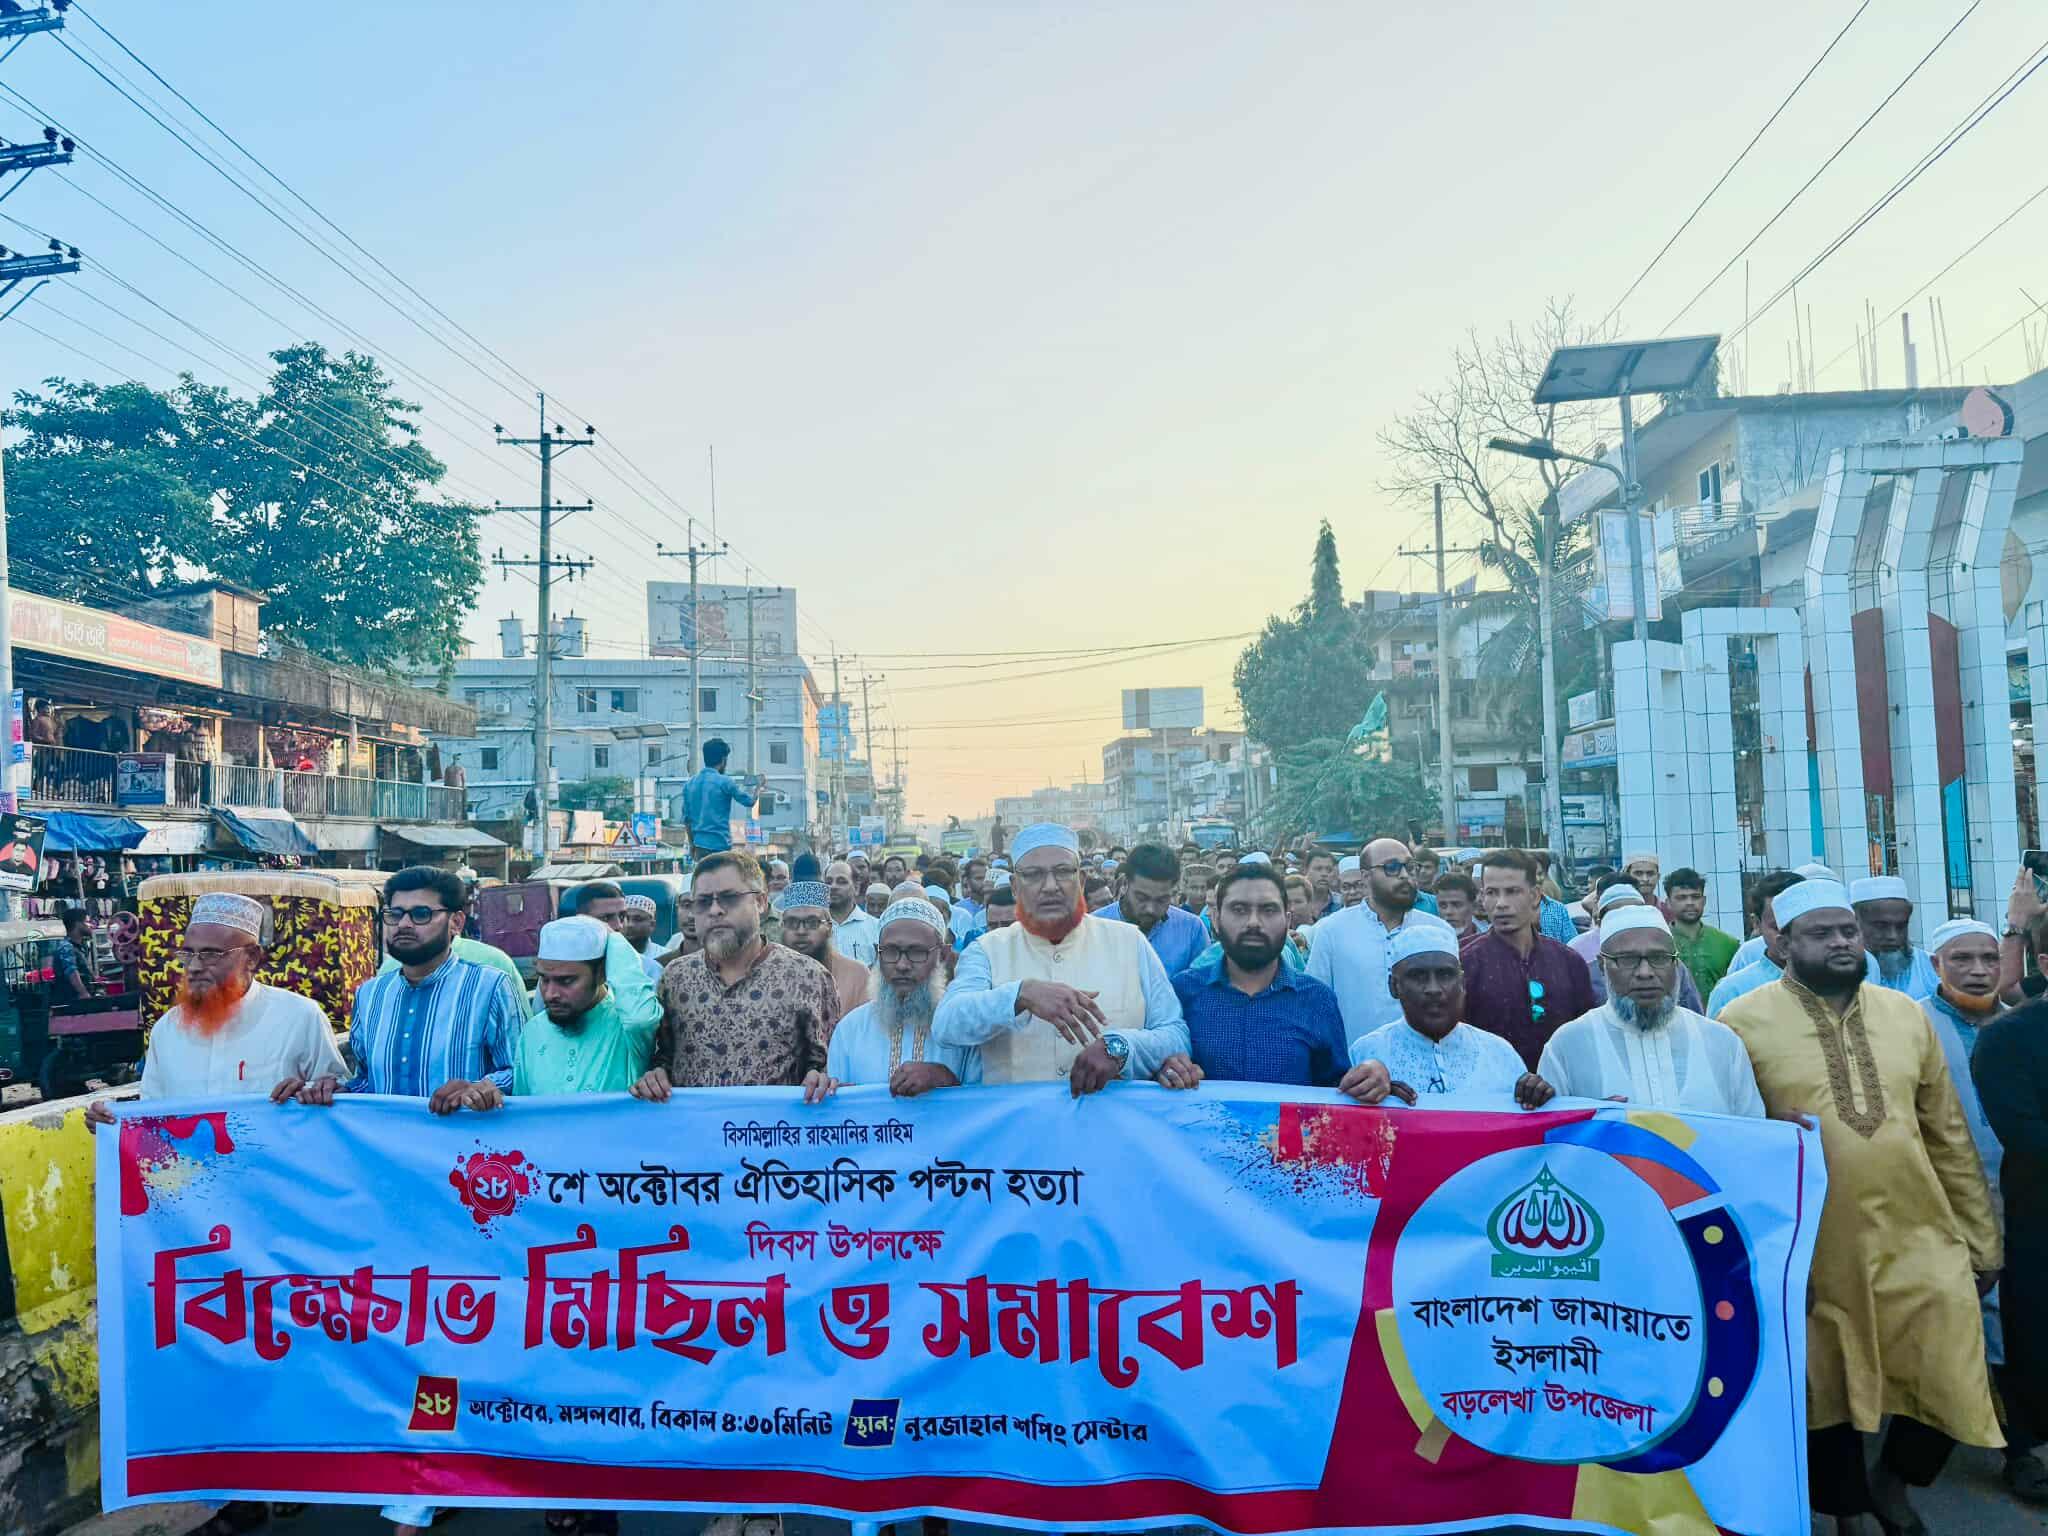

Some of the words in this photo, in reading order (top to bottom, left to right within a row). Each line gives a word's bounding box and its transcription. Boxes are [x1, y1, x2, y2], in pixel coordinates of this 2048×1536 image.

[723, 1121, 801, 1148] বিসমিল্লাহির
[806, 1119, 868, 1146] রাহমানির
[874, 1118, 914, 1144] রাহিম
[474, 1172, 509, 1200] ২৮
[545, 1168, 589, 1205] শে
[597, 1160, 724, 1206] অক্টোবর
[735, 1156, 897, 1205] ঐতিহাসিক
[908, 1156, 994, 1203] পল্টন
[1003, 1166, 1085, 1206] হত্যা
[744, 1220, 818, 1261] দিবস
[827, 1219, 944, 1261] উপলক্ষে
[148, 1224, 501, 1361] বিক্ষোভ
[523, 1223, 791, 1365] মিছিল
[820, 1282, 890, 1360] ও
[919, 1274, 1304, 1389] সমাবেশ
[1410, 1295, 1541, 1328] বাংলাদেশ
[1550, 1297, 1693, 1341] জামায়াতে
[1491, 1335, 1602, 1375] ইসলামী
[417, 1391, 452, 1417] ২৮
[468, 1397, 553, 1425] অক্টোবর,
[651, 1400, 718, 1432] বিকাল
[904, 1413, 1008, 1442] নুরজাহান
[1012, 1413, 1067, 1448] শপিং
[1072, 1416, 1149, 1446] সেন্টার
[1441, 1385, 1536, 1420] বড়লেখা
[1542, 1380, 1658, 1433] উপজেলা
